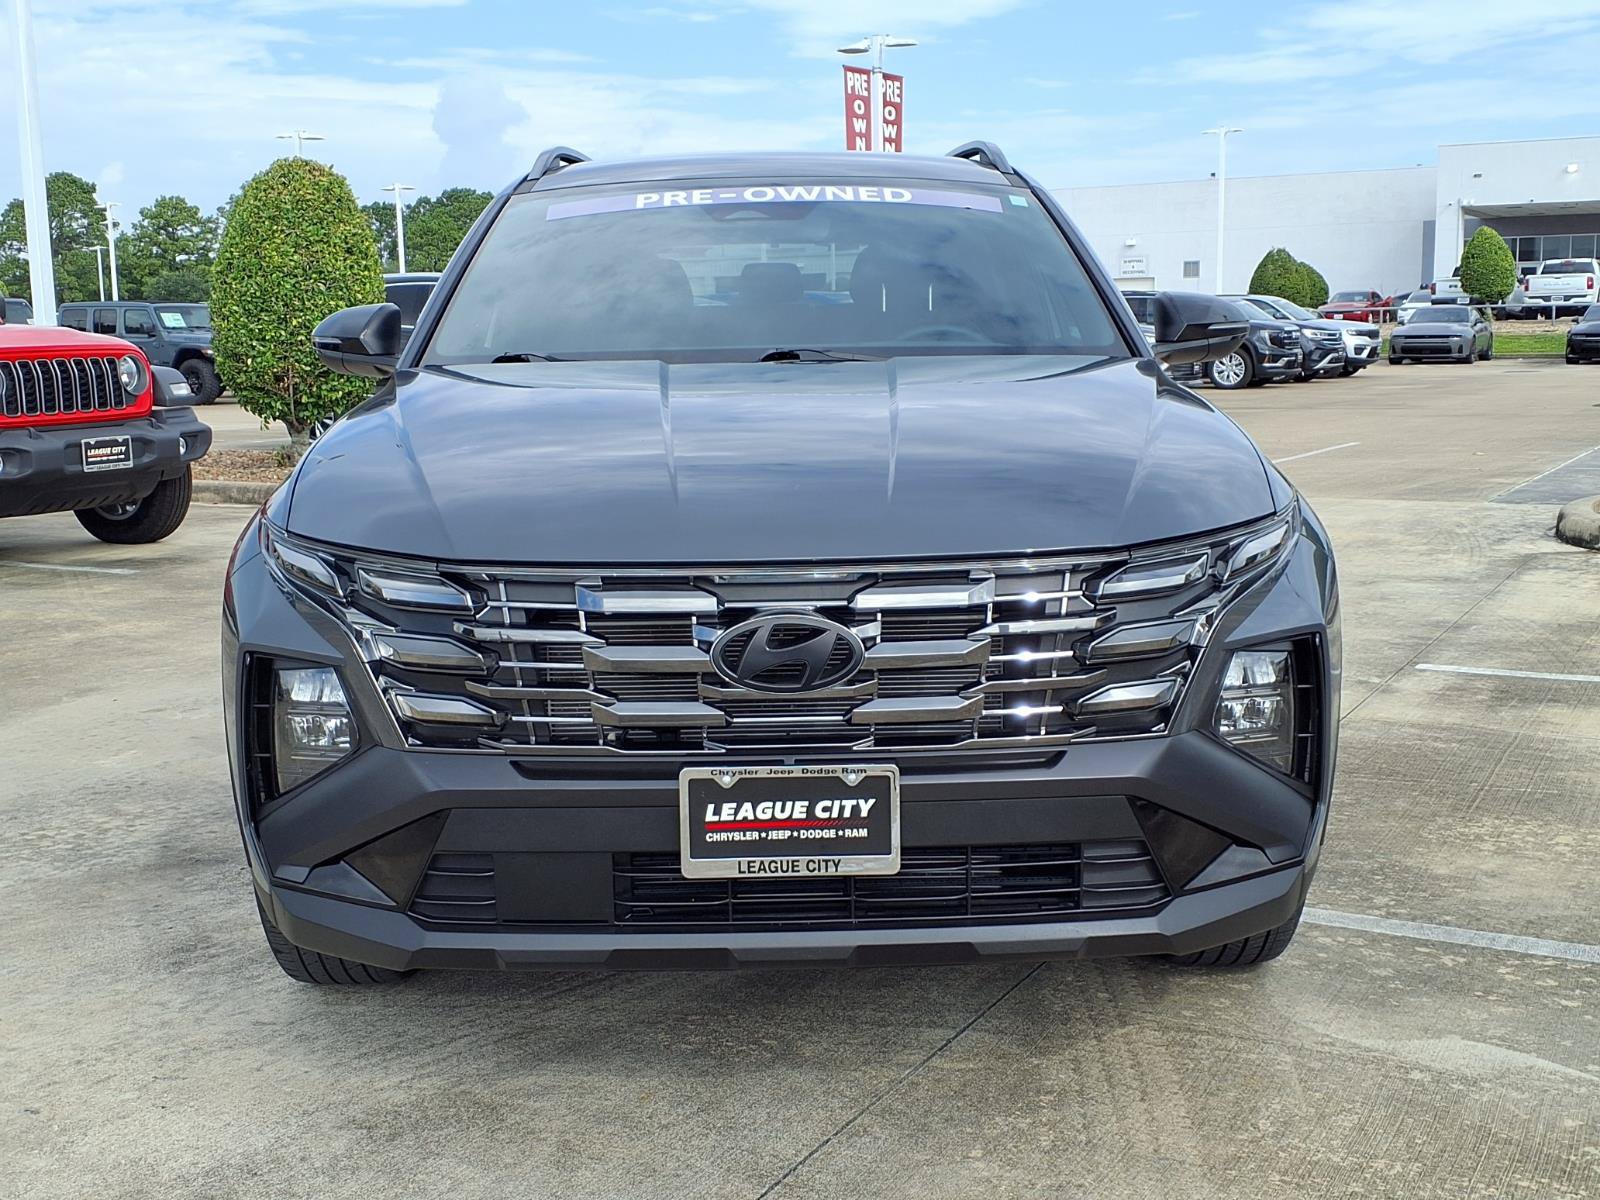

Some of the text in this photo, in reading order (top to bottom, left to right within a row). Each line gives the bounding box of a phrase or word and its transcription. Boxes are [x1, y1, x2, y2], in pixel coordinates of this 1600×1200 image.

[846, 71, 868, 96] PRE
[880, 78, 901, 103] PRE
[635, 186, 912, 208] PRE-OWNED
[87, 446, 126, 455] LEAGUE CITY
[710, 769, 760, 777] Chrysler
[801, 767, 838, 775] Dodge
[841, 767, 867, 775] Ram
[705, 799, 876, 822] LEAGUE CITY
[705, 828, 868, 842] CHRYSLER JEEP DODGE RAM
[737, 858, 842, 875] LEAGUE CITY
